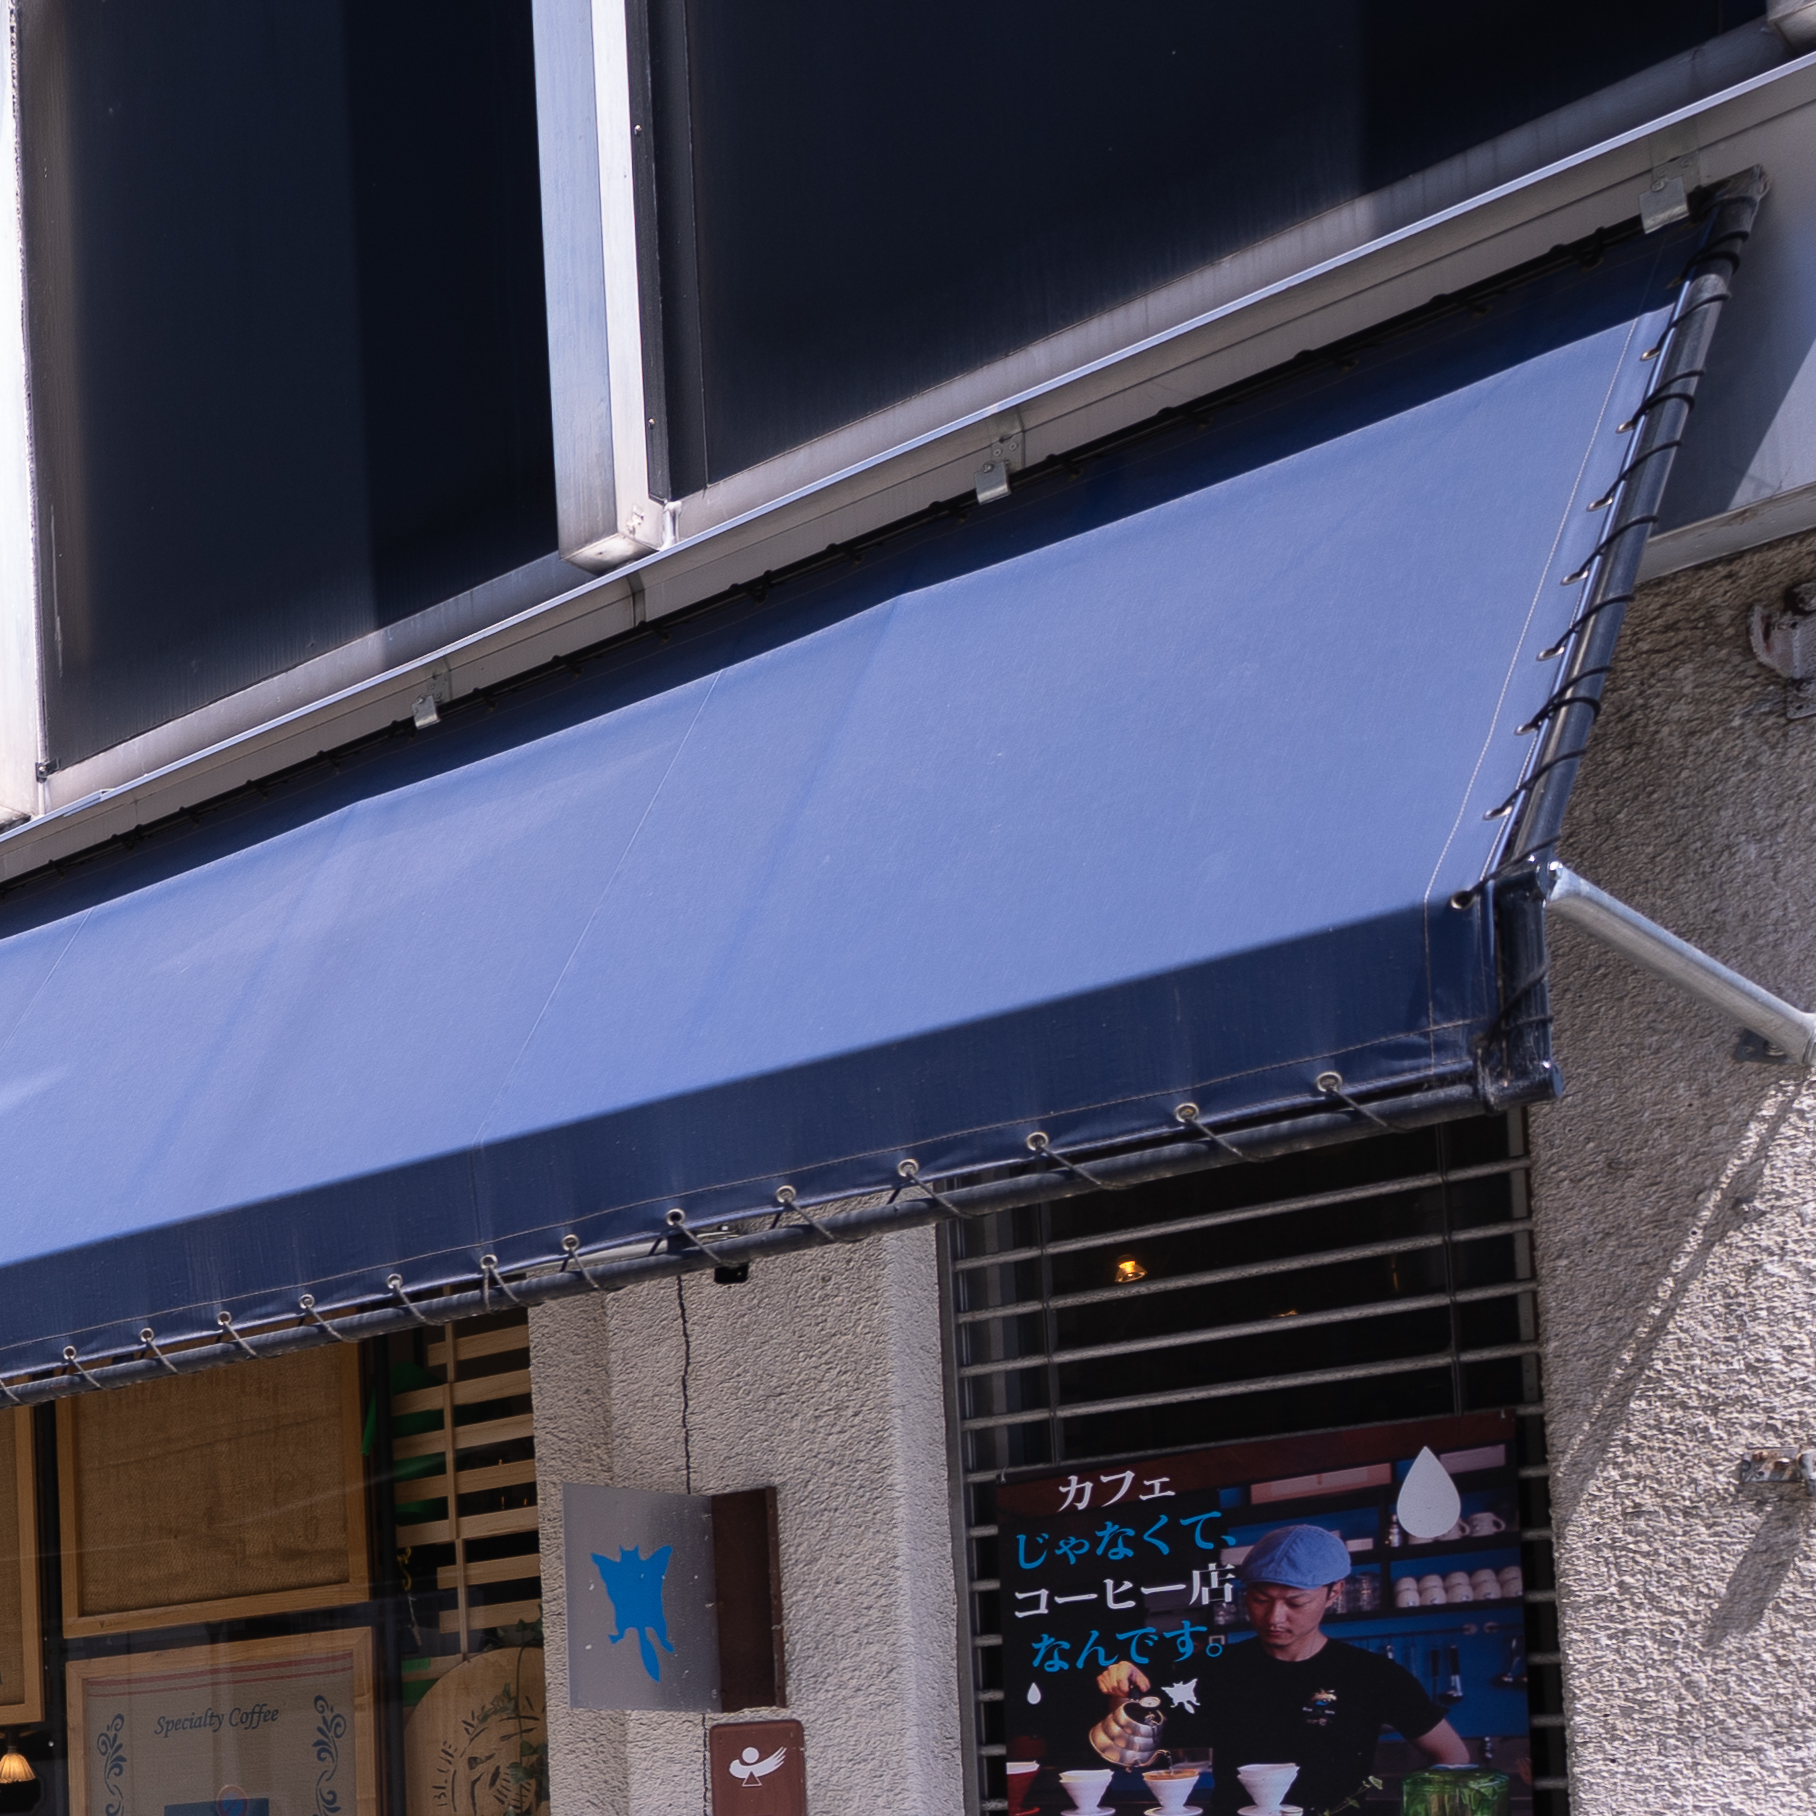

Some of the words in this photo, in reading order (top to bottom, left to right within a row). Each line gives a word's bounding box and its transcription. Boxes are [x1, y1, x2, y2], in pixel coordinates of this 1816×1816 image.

[1056, 1470, 1176, 1513] カフェ
[1016, 1510, 1236, 1570] じゃなくて、
[1014, 1562, 1236, 1619] コーヒー店
[1031, 1620, 1223, 1673] なんです。
[154, 1707, 226, 1738] Specialty
[228, 1703, 280, 1730] Coffee
